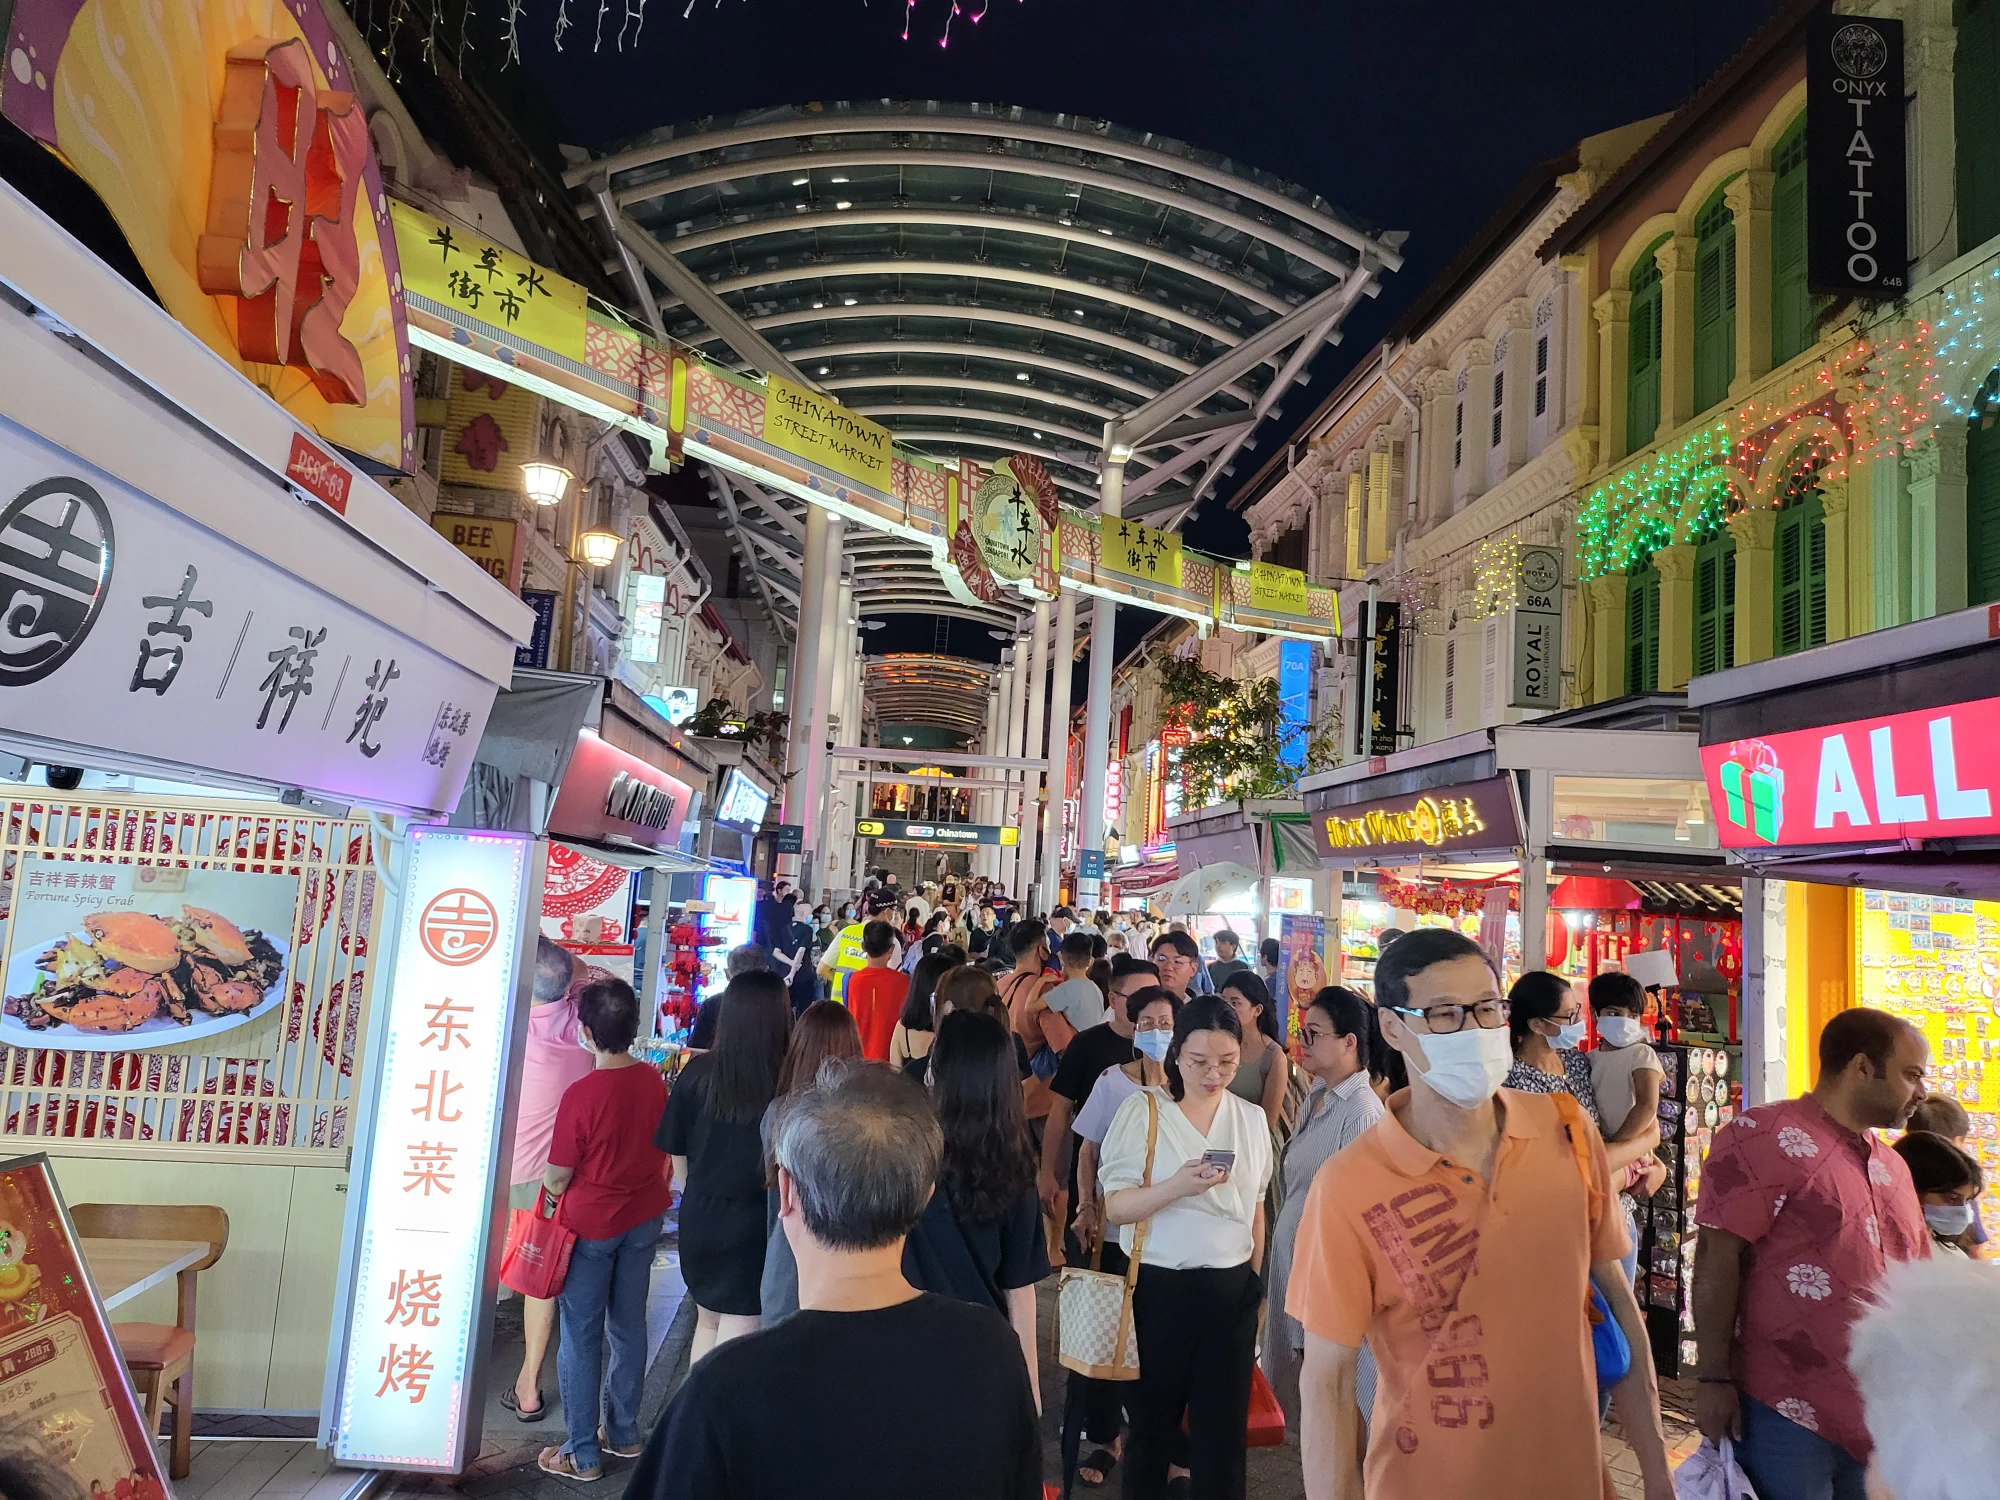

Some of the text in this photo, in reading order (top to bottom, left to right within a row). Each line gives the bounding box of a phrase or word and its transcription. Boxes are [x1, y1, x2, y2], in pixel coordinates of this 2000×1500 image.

[1832, 78, 1887, 97] ONYX
[1845, 98, 1878, 283] TATTOO
[428, 225, 552, 298] 牛车水
[1882, 276, 1903, 288] 64B
[447, 269, 527, 328] 街市
[775, 387, 885, 450] CHINATOWN
[773, 414, 885, 472] STREET MARKET
[452, 524, 493, 548] BEE
[1007, 482, 1035, 570] 牛车水
[1117, 521, 1169, 554] 牛车水
[1126, 548, 1159, 579] 街市
[1253, 567, 1306, 589] CHINATOWN
[1526, 570, 1554, 579] ROYAL
[1254, 585, 1305, 604] STREET MARKET
[1527, 595, 1552, 608] 66A
[1285, 660, 1305, 672] 70A
[1525, 624, 1542, 699] ROYAL
[1542, 625, 1550, 699] LODGE CHINATOWN
[1813, 716, 1993, 829] ALL
[936, 828, 979, 840] Chinatown
[28, 870, 116, 891] 吉祥香辣蟹
[25, 890, 135, 909] Fortune Spicy Crab
[374, 996, 475, 1404] 东北菜 烧烤
